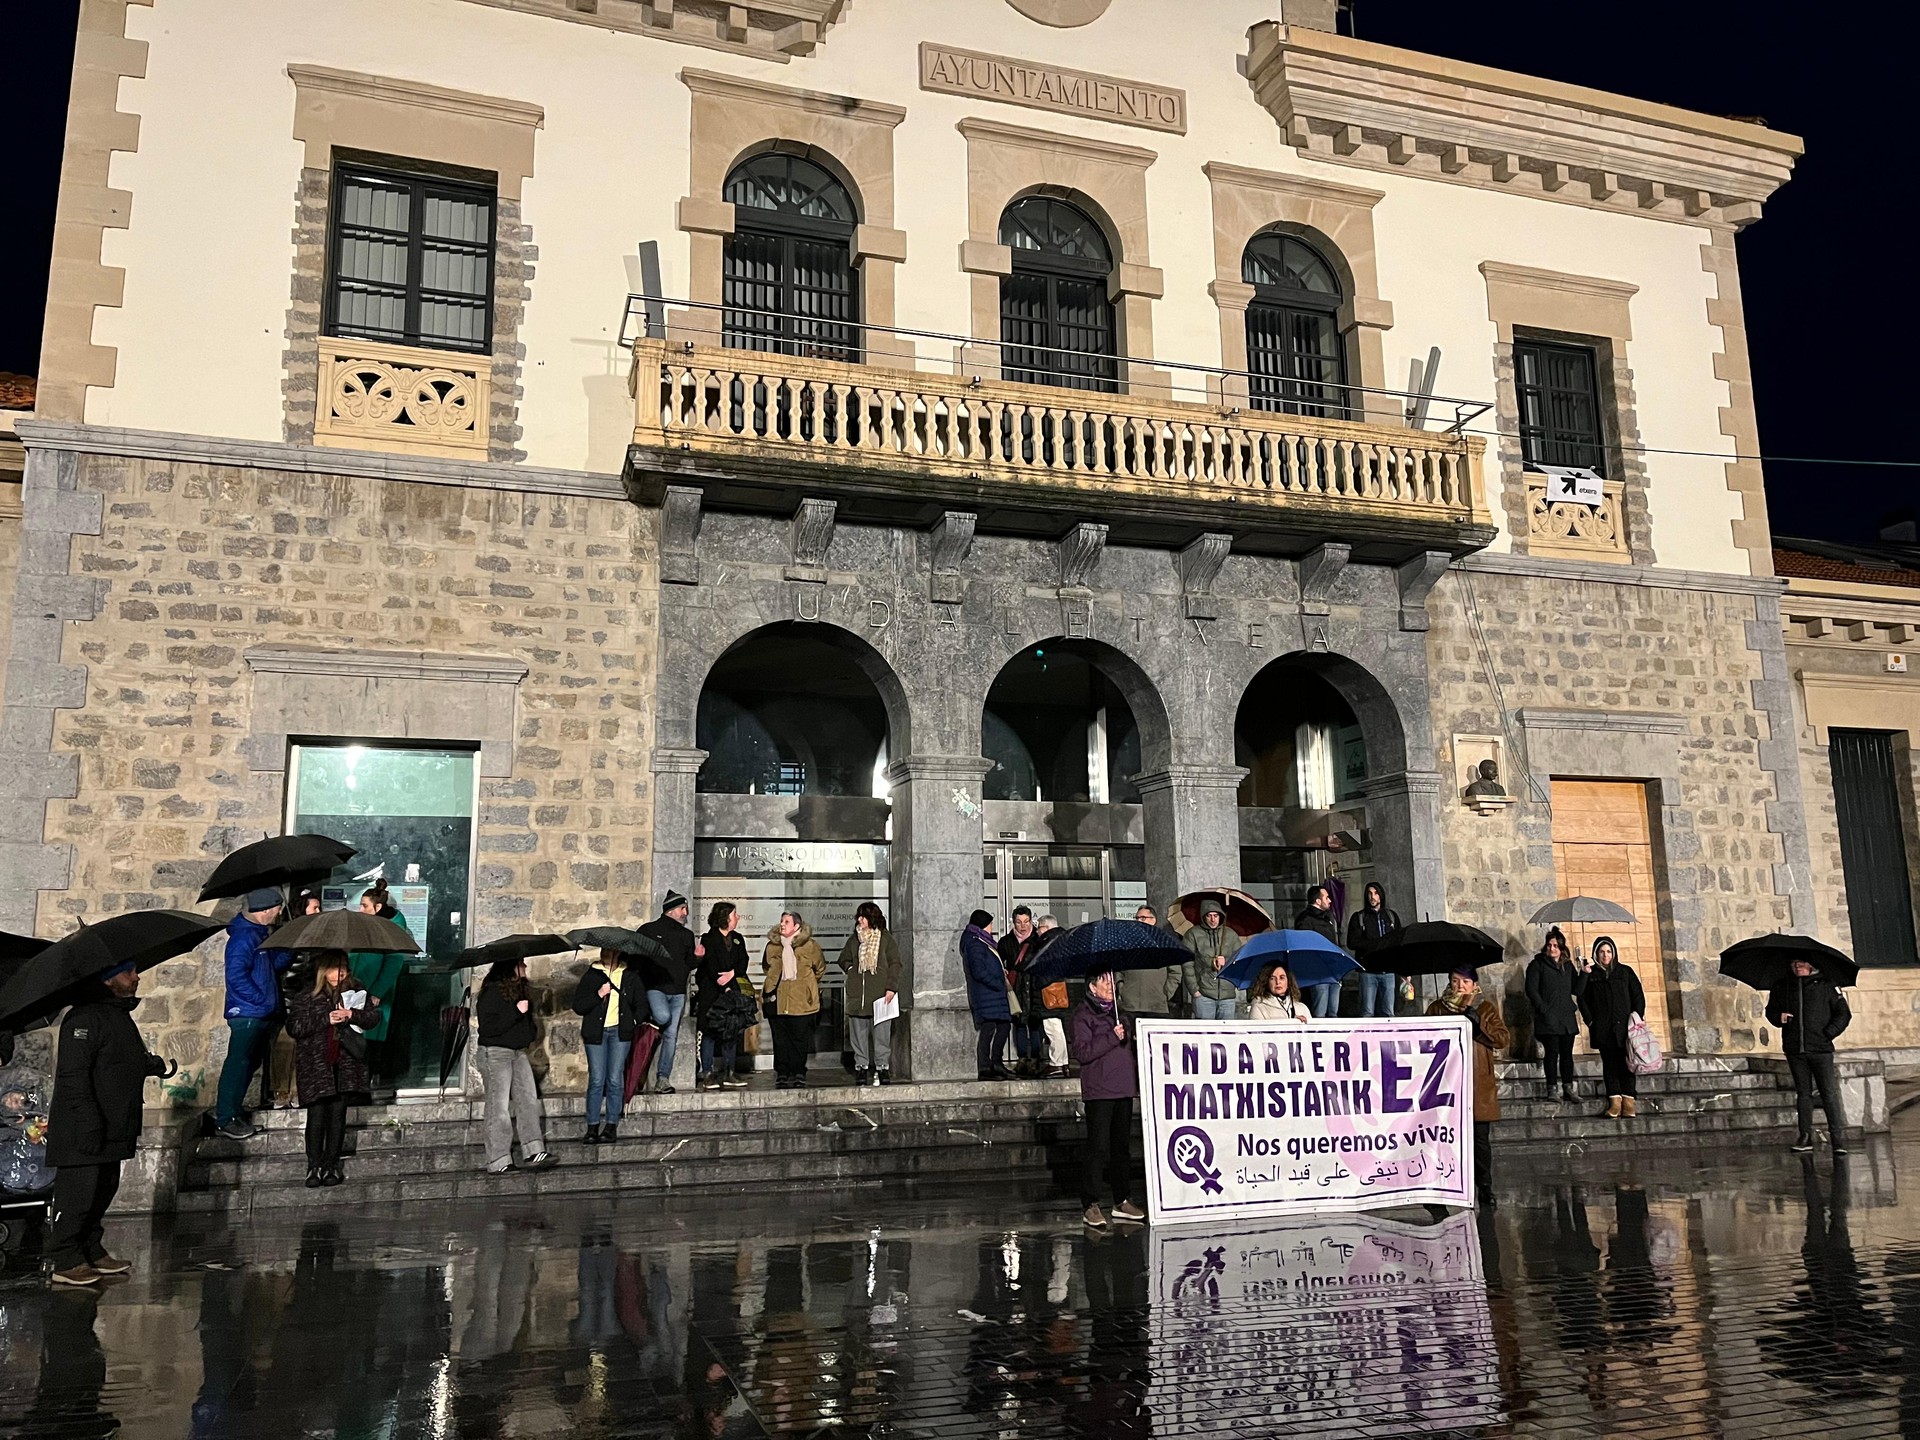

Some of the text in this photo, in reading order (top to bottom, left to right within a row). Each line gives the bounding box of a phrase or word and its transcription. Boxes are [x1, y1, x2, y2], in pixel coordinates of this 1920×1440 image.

[930, 52, 1178, 123] AYUNTAMIENTO
[1162, 1040, 1370, 1076] INDARKERI
[1379, 1038, 1456, 1115] EZ
[1163, 1079, 1372, 1121] MATXISTARIK
[1237, 1123, 1455, 1161] Nos queremos vivas
[1236, 1164, 1281, 1189] الحياة
[1288, 1163, 1311, 1187] قيد
[1317, 1162, 1350, 1187] على
[1360, 1160, 1399, 1186] نبقى
[1407, 1149, 1427, 1177] أن
